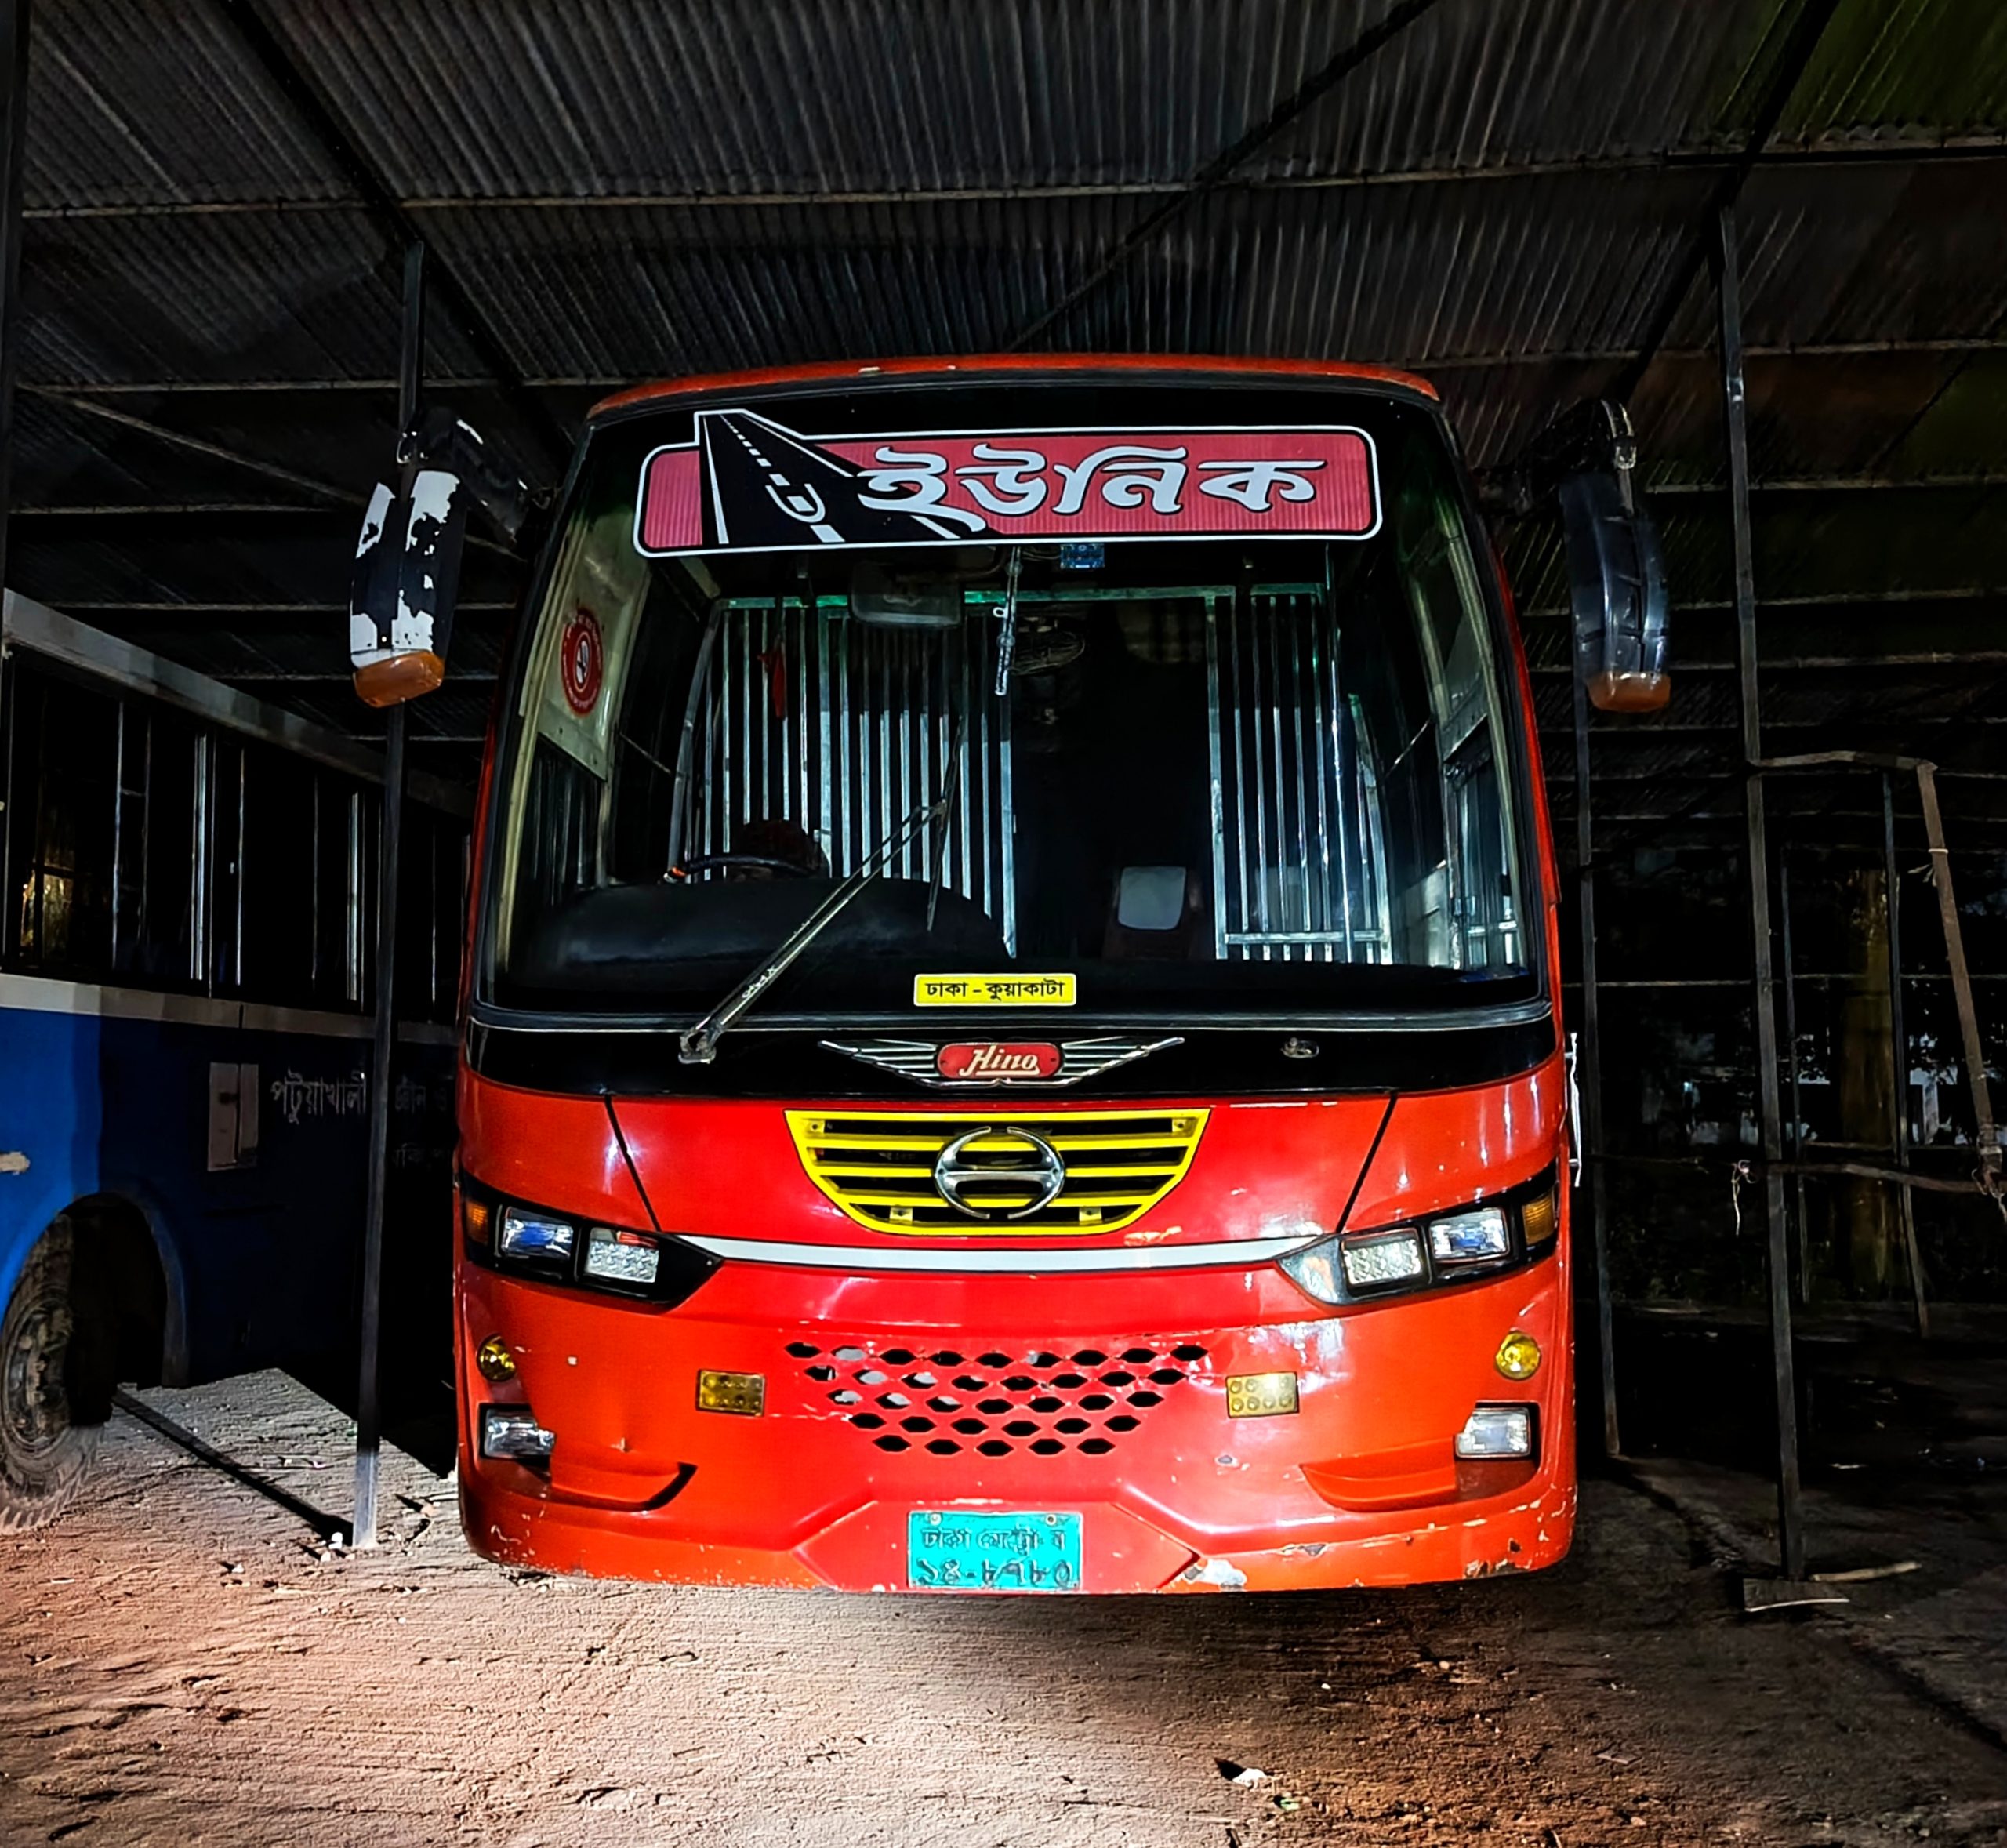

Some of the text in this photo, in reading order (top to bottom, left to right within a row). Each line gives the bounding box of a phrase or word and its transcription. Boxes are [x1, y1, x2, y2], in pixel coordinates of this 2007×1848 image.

[856, 442, 1327, 532] ইউনিক
[925, 981, 968, 997] ঢাকা
[985, 978, 1065, 1001] কুয়াকাটা
[960, 1044, 1040, 1077] Hino
[920, 1527, 971, 1549] ঢাকা
